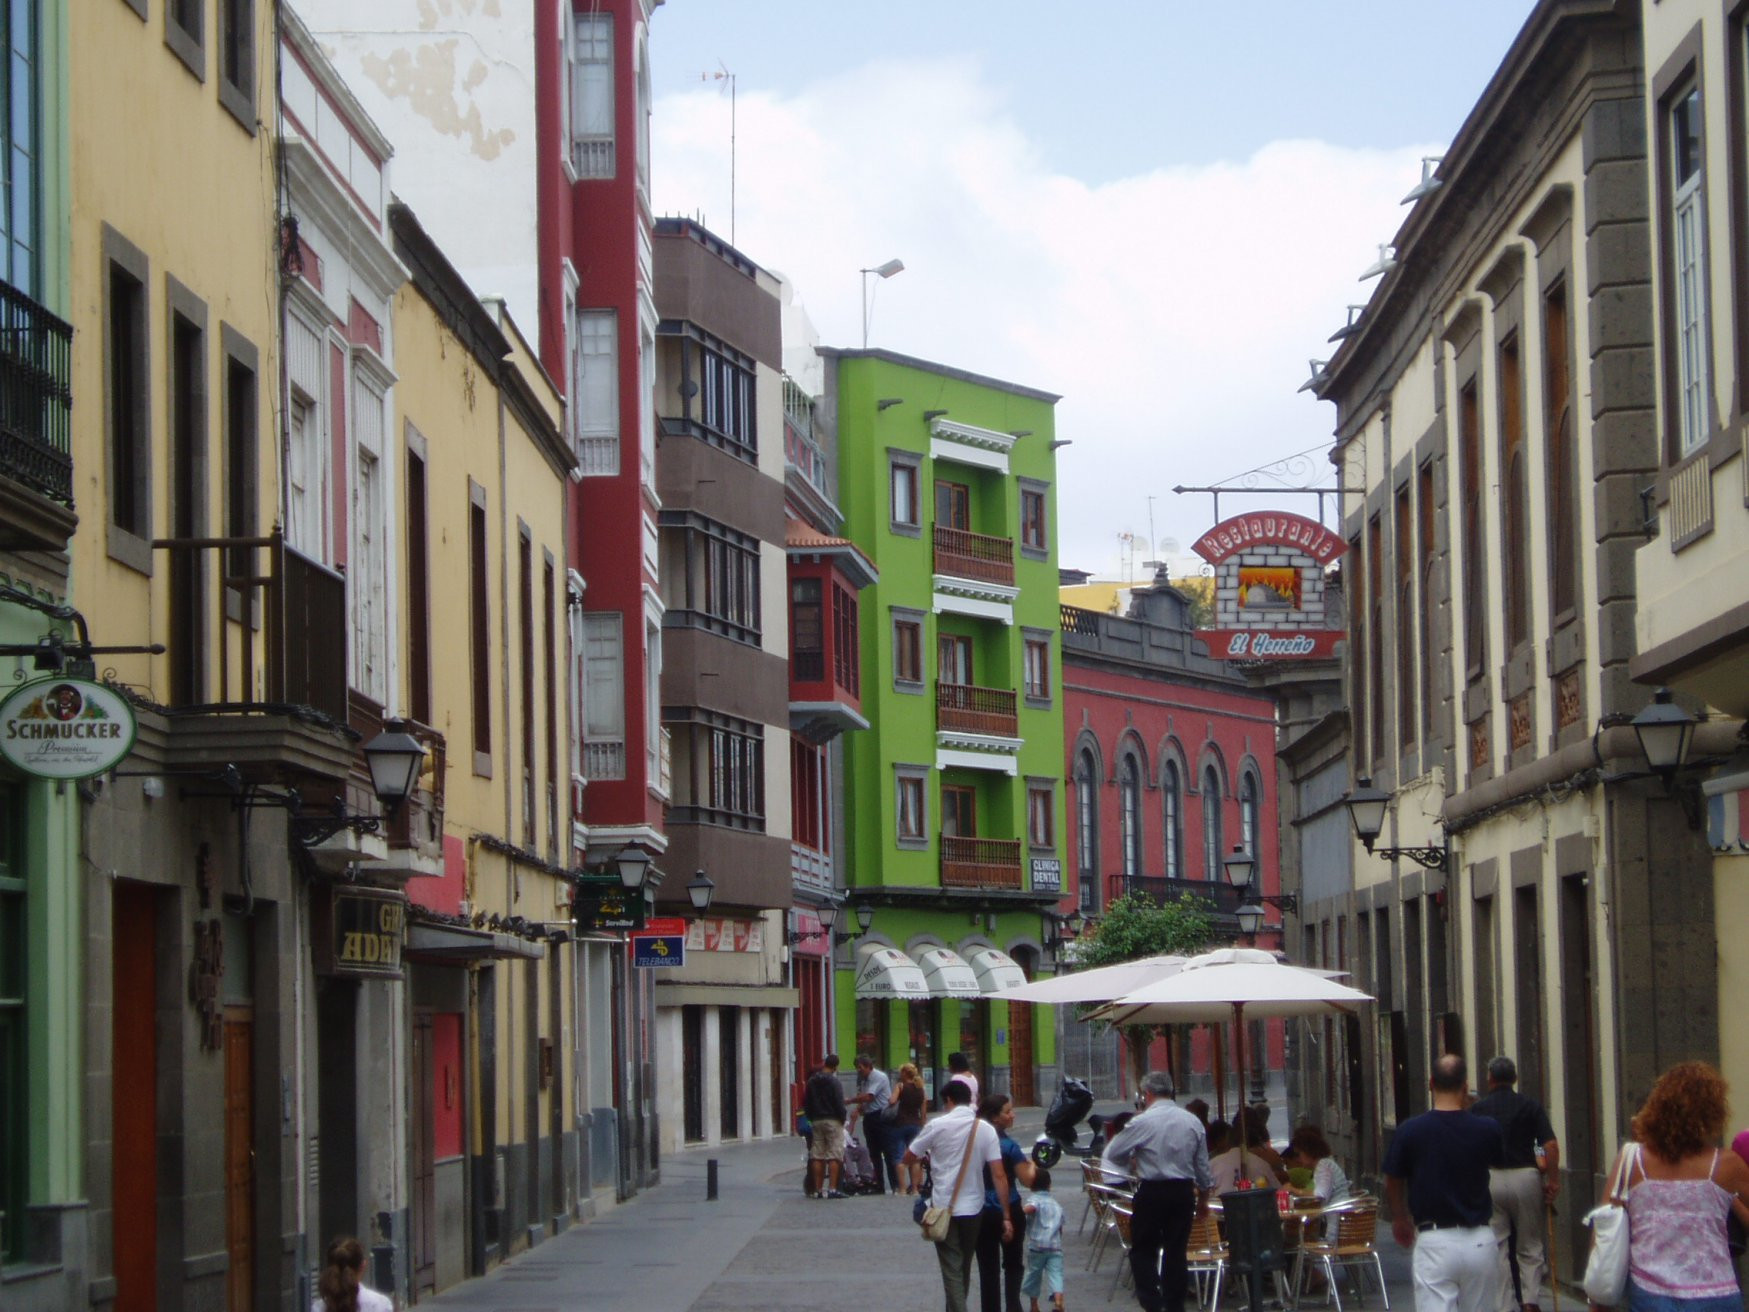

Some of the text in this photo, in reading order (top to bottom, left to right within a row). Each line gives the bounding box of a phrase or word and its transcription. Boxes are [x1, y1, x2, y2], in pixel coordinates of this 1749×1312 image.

[1202, 518, 1334, 557] Restaurante
[1228, 633, 1315, 656] El Herreño
[7, 720, 121, 739] SCHMUCKER
[1033, 871, 1061, 884] DENTAL
